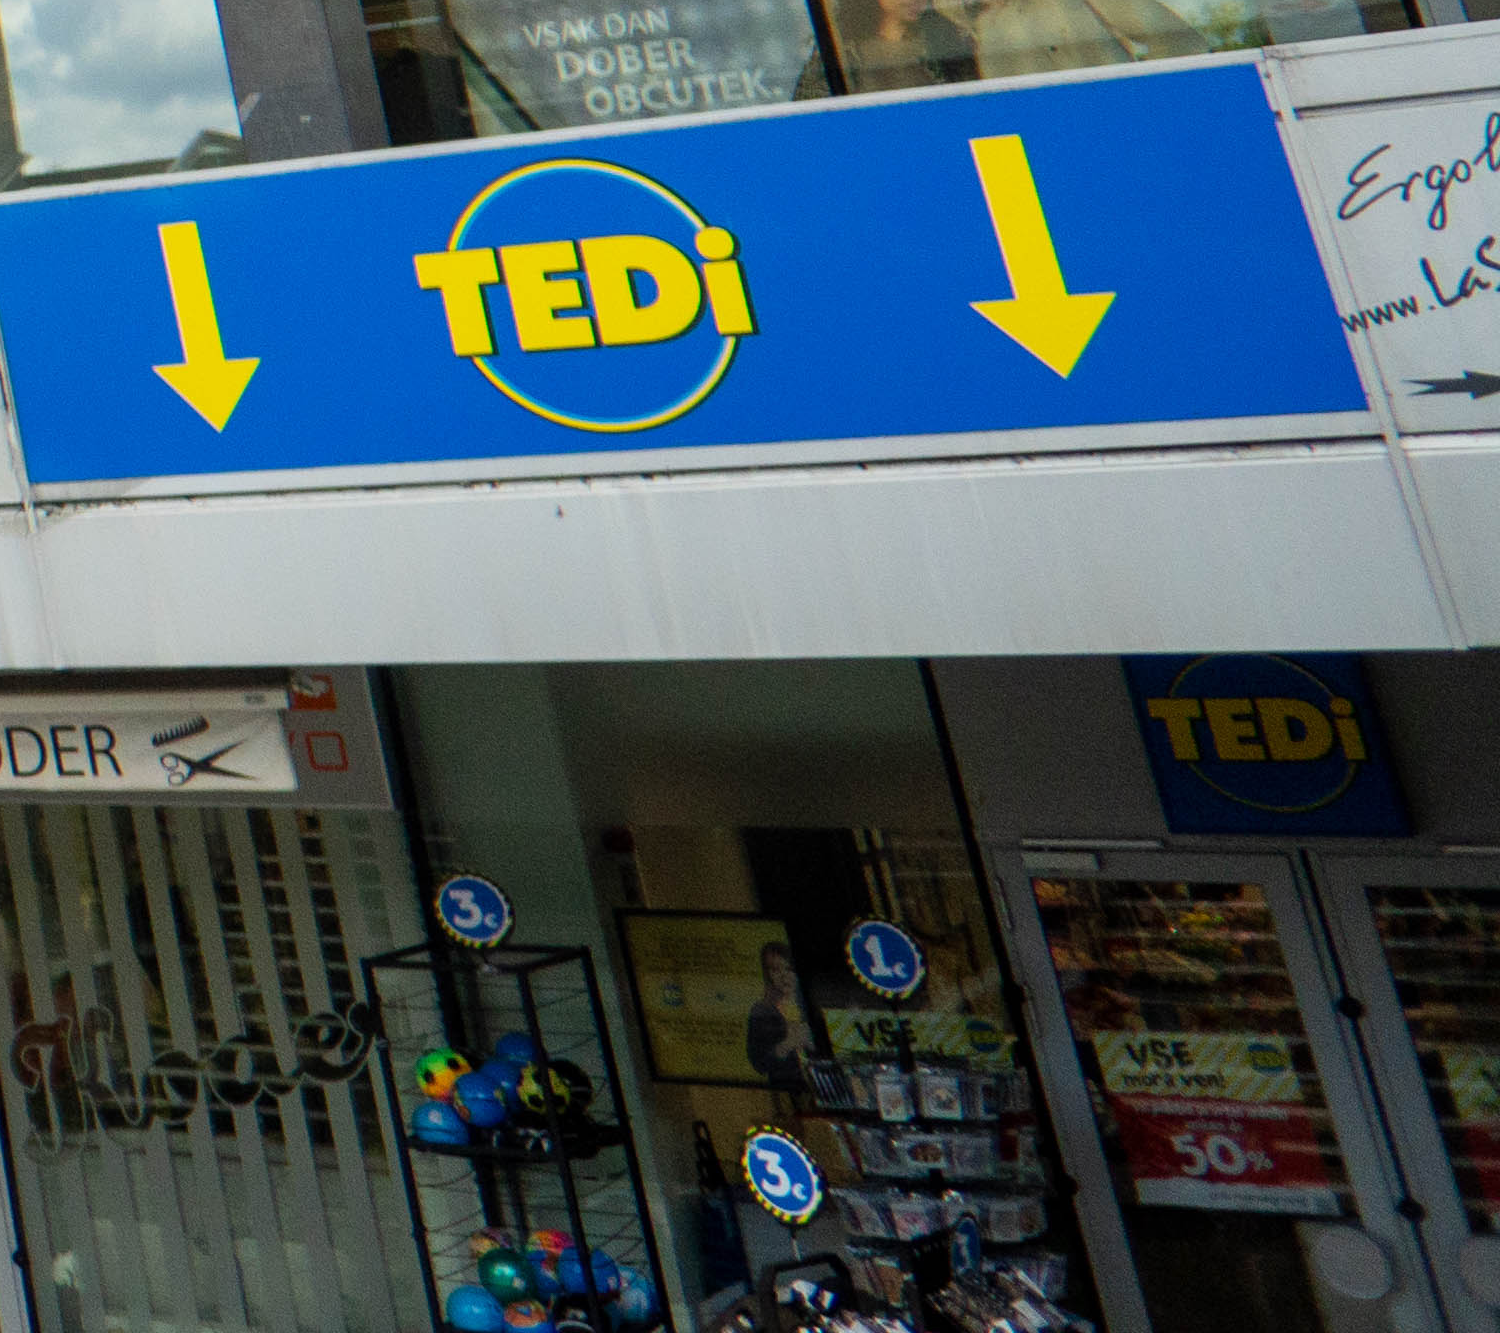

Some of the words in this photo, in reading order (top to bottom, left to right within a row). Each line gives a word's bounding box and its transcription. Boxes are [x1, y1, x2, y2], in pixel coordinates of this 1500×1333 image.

[522, 19, 596, 48] VSAK
[604, 8, 670, 39] DAN
[555, 37, 696, 82] DOBER
[413, 226, 756, 356] TEDi
[1147, 697, 1367, 761] TEDi
[1126, 1041, 1194, 1069] VSE
[1170, 1134, 1275, 1177] 50%
